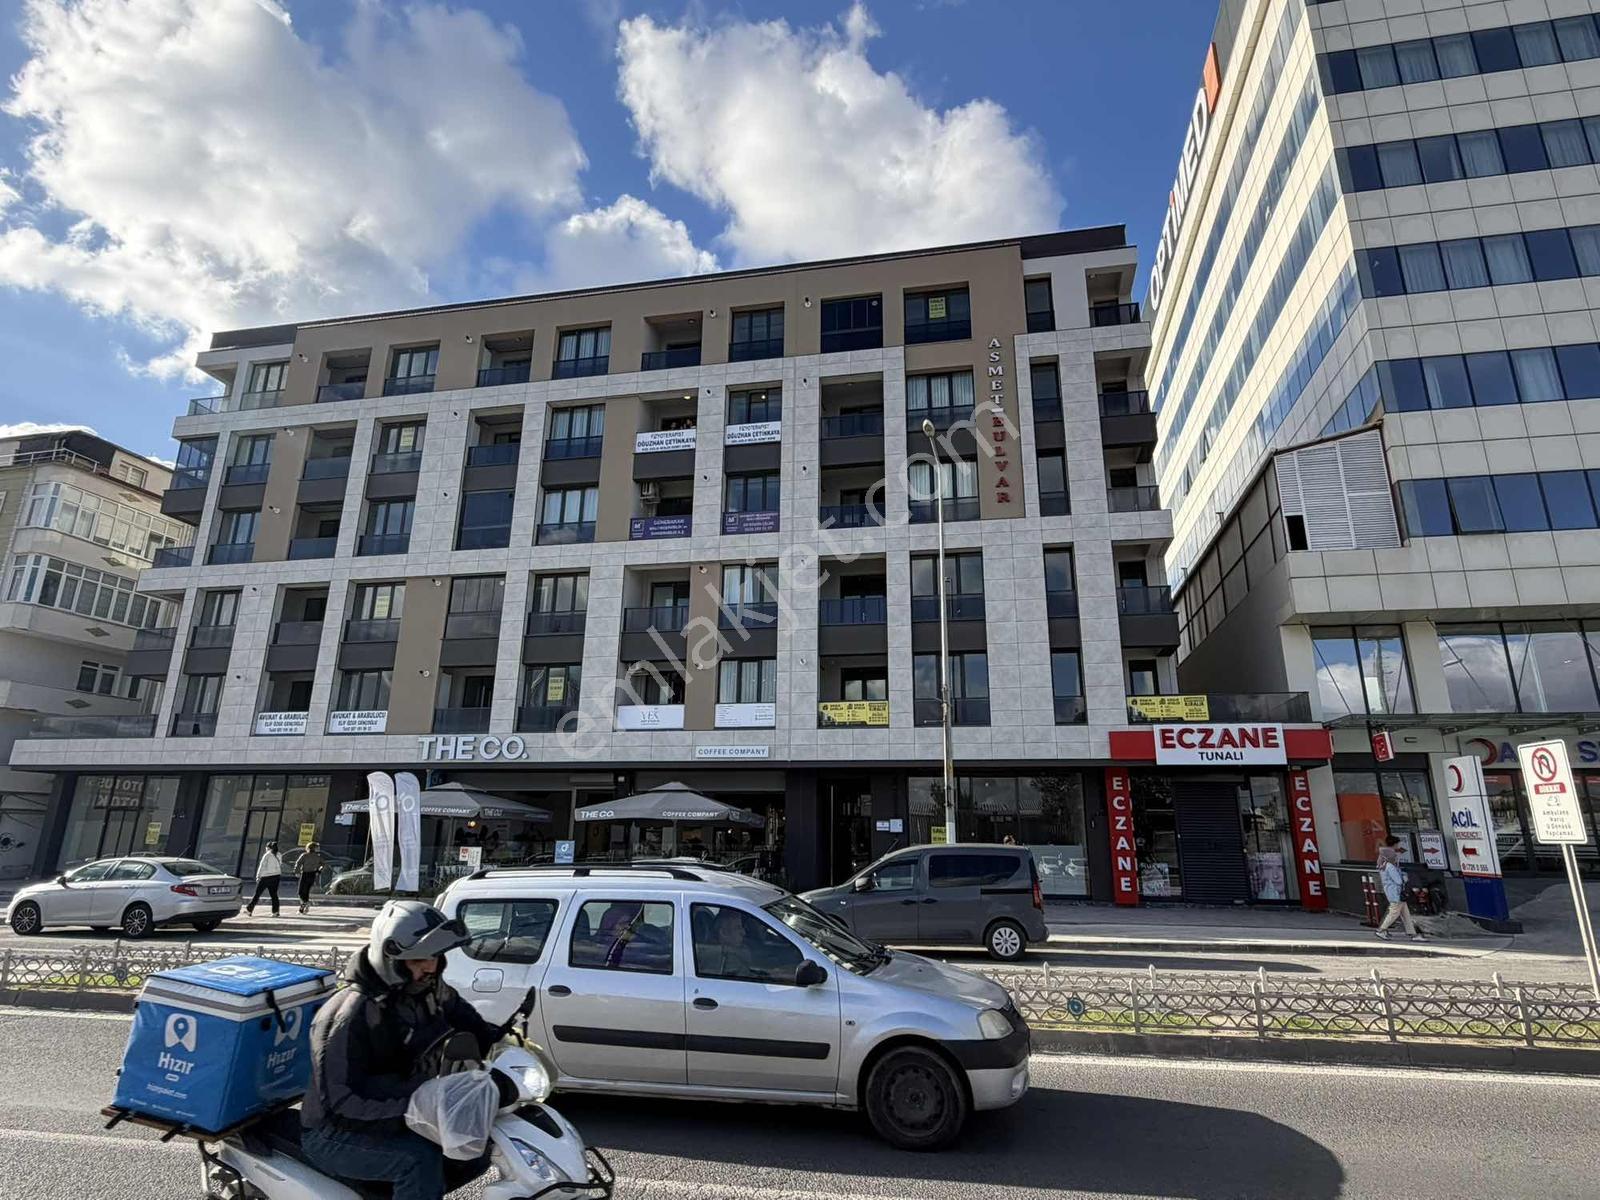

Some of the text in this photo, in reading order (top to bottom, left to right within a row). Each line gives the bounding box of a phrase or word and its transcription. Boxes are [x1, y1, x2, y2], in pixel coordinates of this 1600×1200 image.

[988, 338, 1004, 404] ASMET
[992, 416, 1011, 504] BULVAR
[418, 735, 528, 760] THE CO.
[1160, 727, 1279, 749] ECZANE
[698, 748, 767, 756] COFFEE COMPANY
[1198, 751, 1243, 761] TUNALI
[1452, 807, 1478, 828] ACİL
[1112, 776, 1132, 892] ECZANE
[1294, 776, 1322, 896] ECZANE
